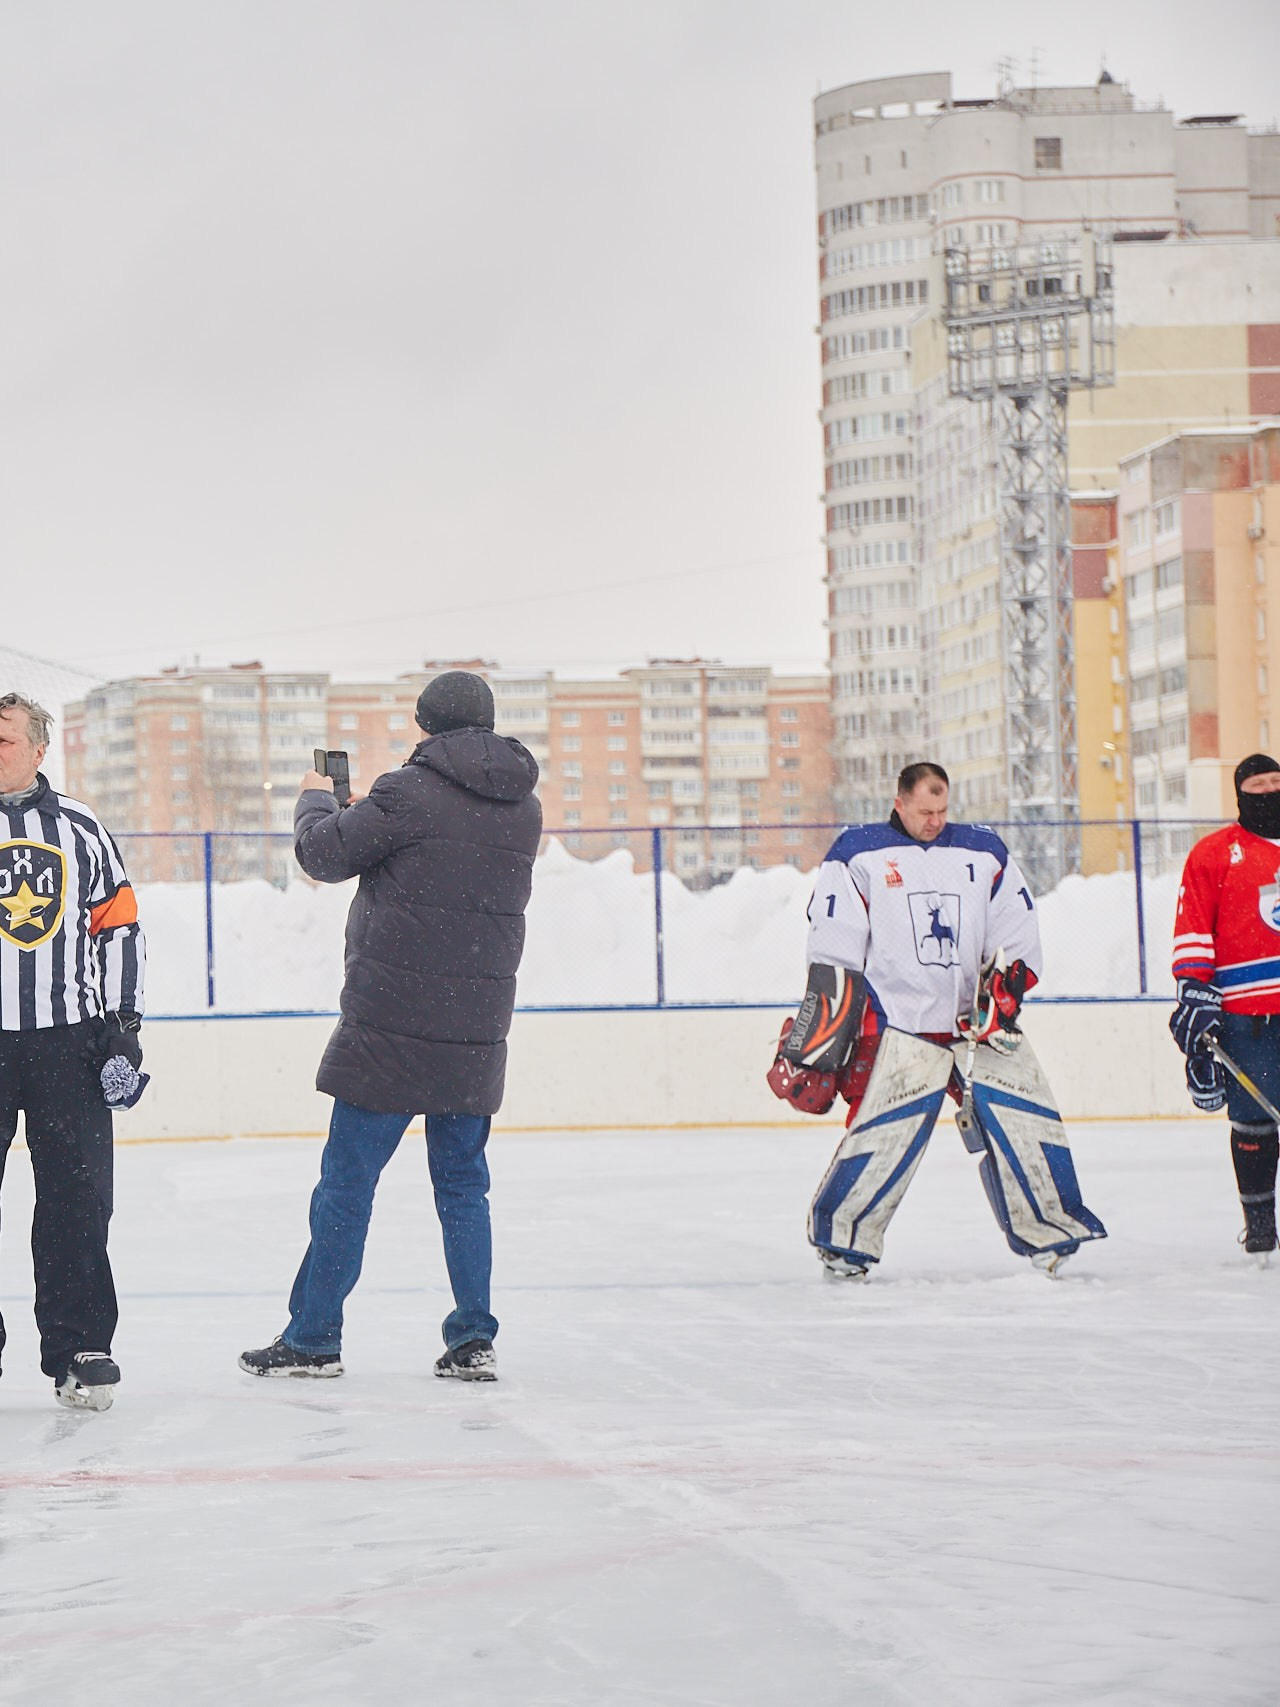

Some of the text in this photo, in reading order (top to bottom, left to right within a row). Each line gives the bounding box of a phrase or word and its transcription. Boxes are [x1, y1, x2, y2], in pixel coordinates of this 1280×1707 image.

[966, 863, 975, 882] 1
[826, 894, 836, 918] 1
[1017, 887, 1033, 911] 1
